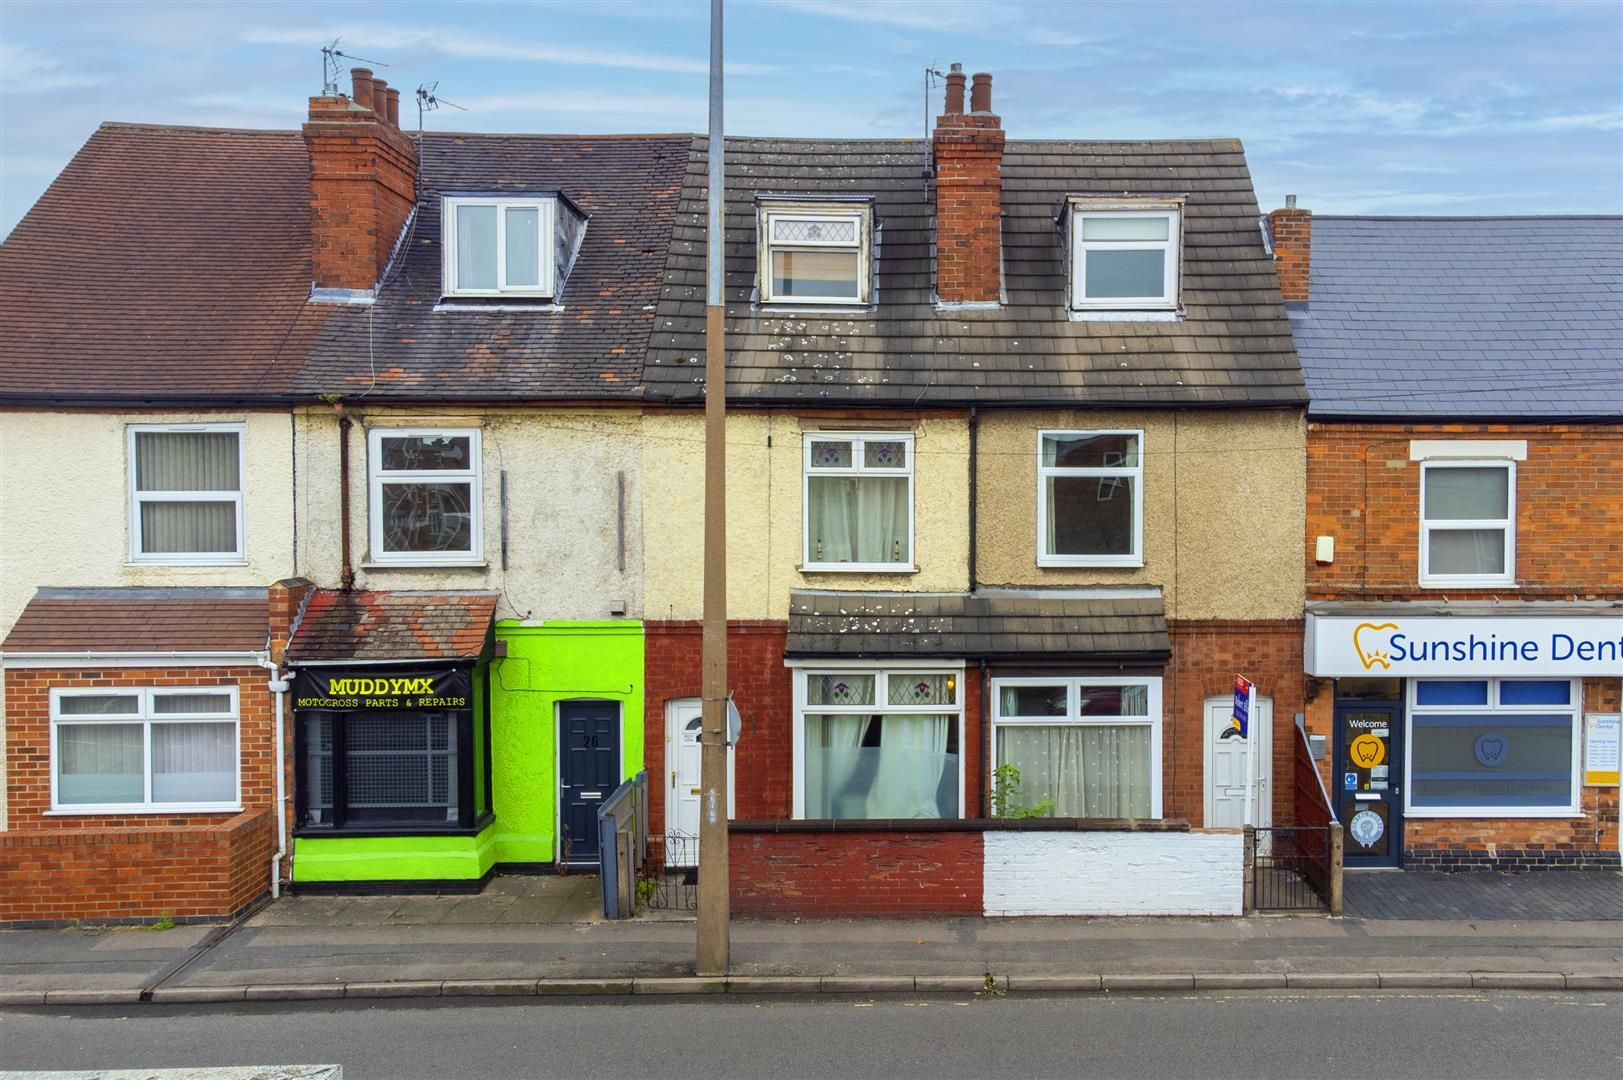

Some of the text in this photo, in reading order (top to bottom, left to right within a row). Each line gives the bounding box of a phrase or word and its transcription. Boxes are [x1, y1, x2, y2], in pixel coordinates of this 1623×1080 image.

[1390, 634, 1538, 661] Sunshine
[329, 678, 434, 695] MUDDYMX
[298, 697, 465, 707] MOTOCROSS PARTS & REPAIRS
[1349, 719, 1388, 728] Welcome
[583, 735, 599, 748] 26
